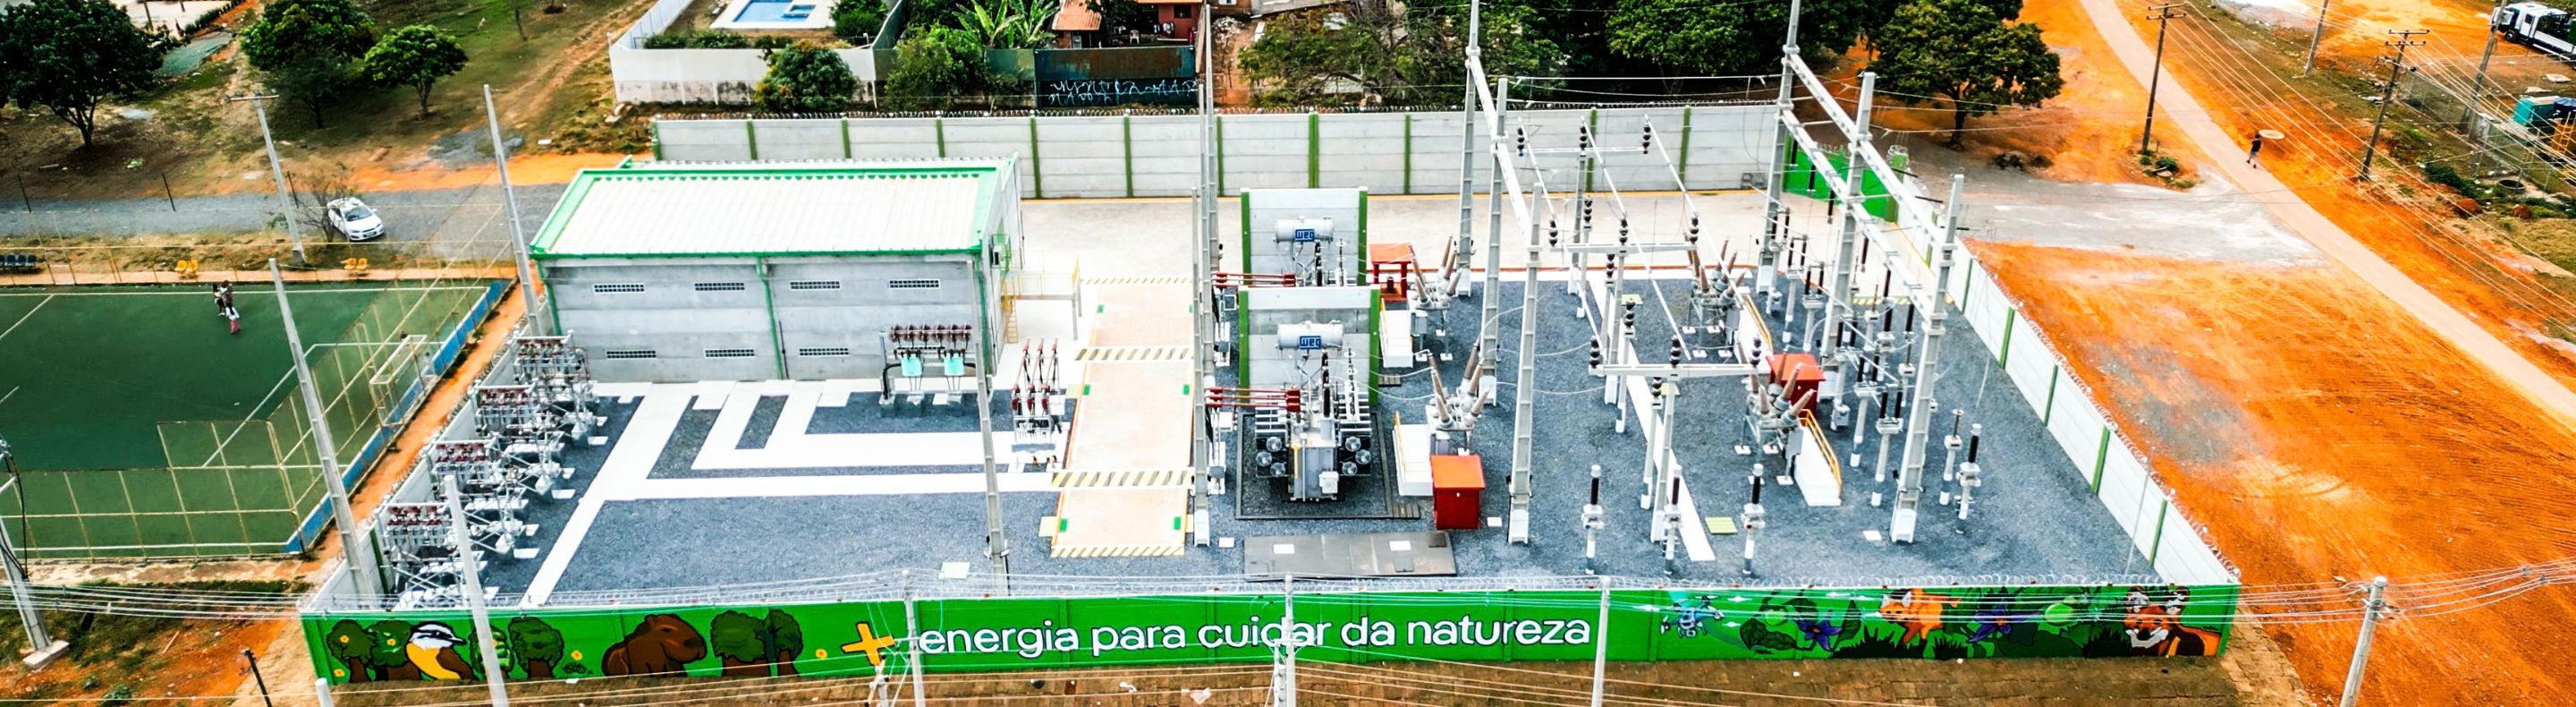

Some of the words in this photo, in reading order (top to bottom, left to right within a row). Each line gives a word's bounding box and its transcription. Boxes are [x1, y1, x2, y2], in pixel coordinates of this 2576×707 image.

[919, 619, 1080, 658] energia
[1092, 625, 1187, 657] para
[1198, 616, 1332, 648] cuidar
[1341, 616, 1395, 646] da
[1407, 614, 1590, 645] natureza
